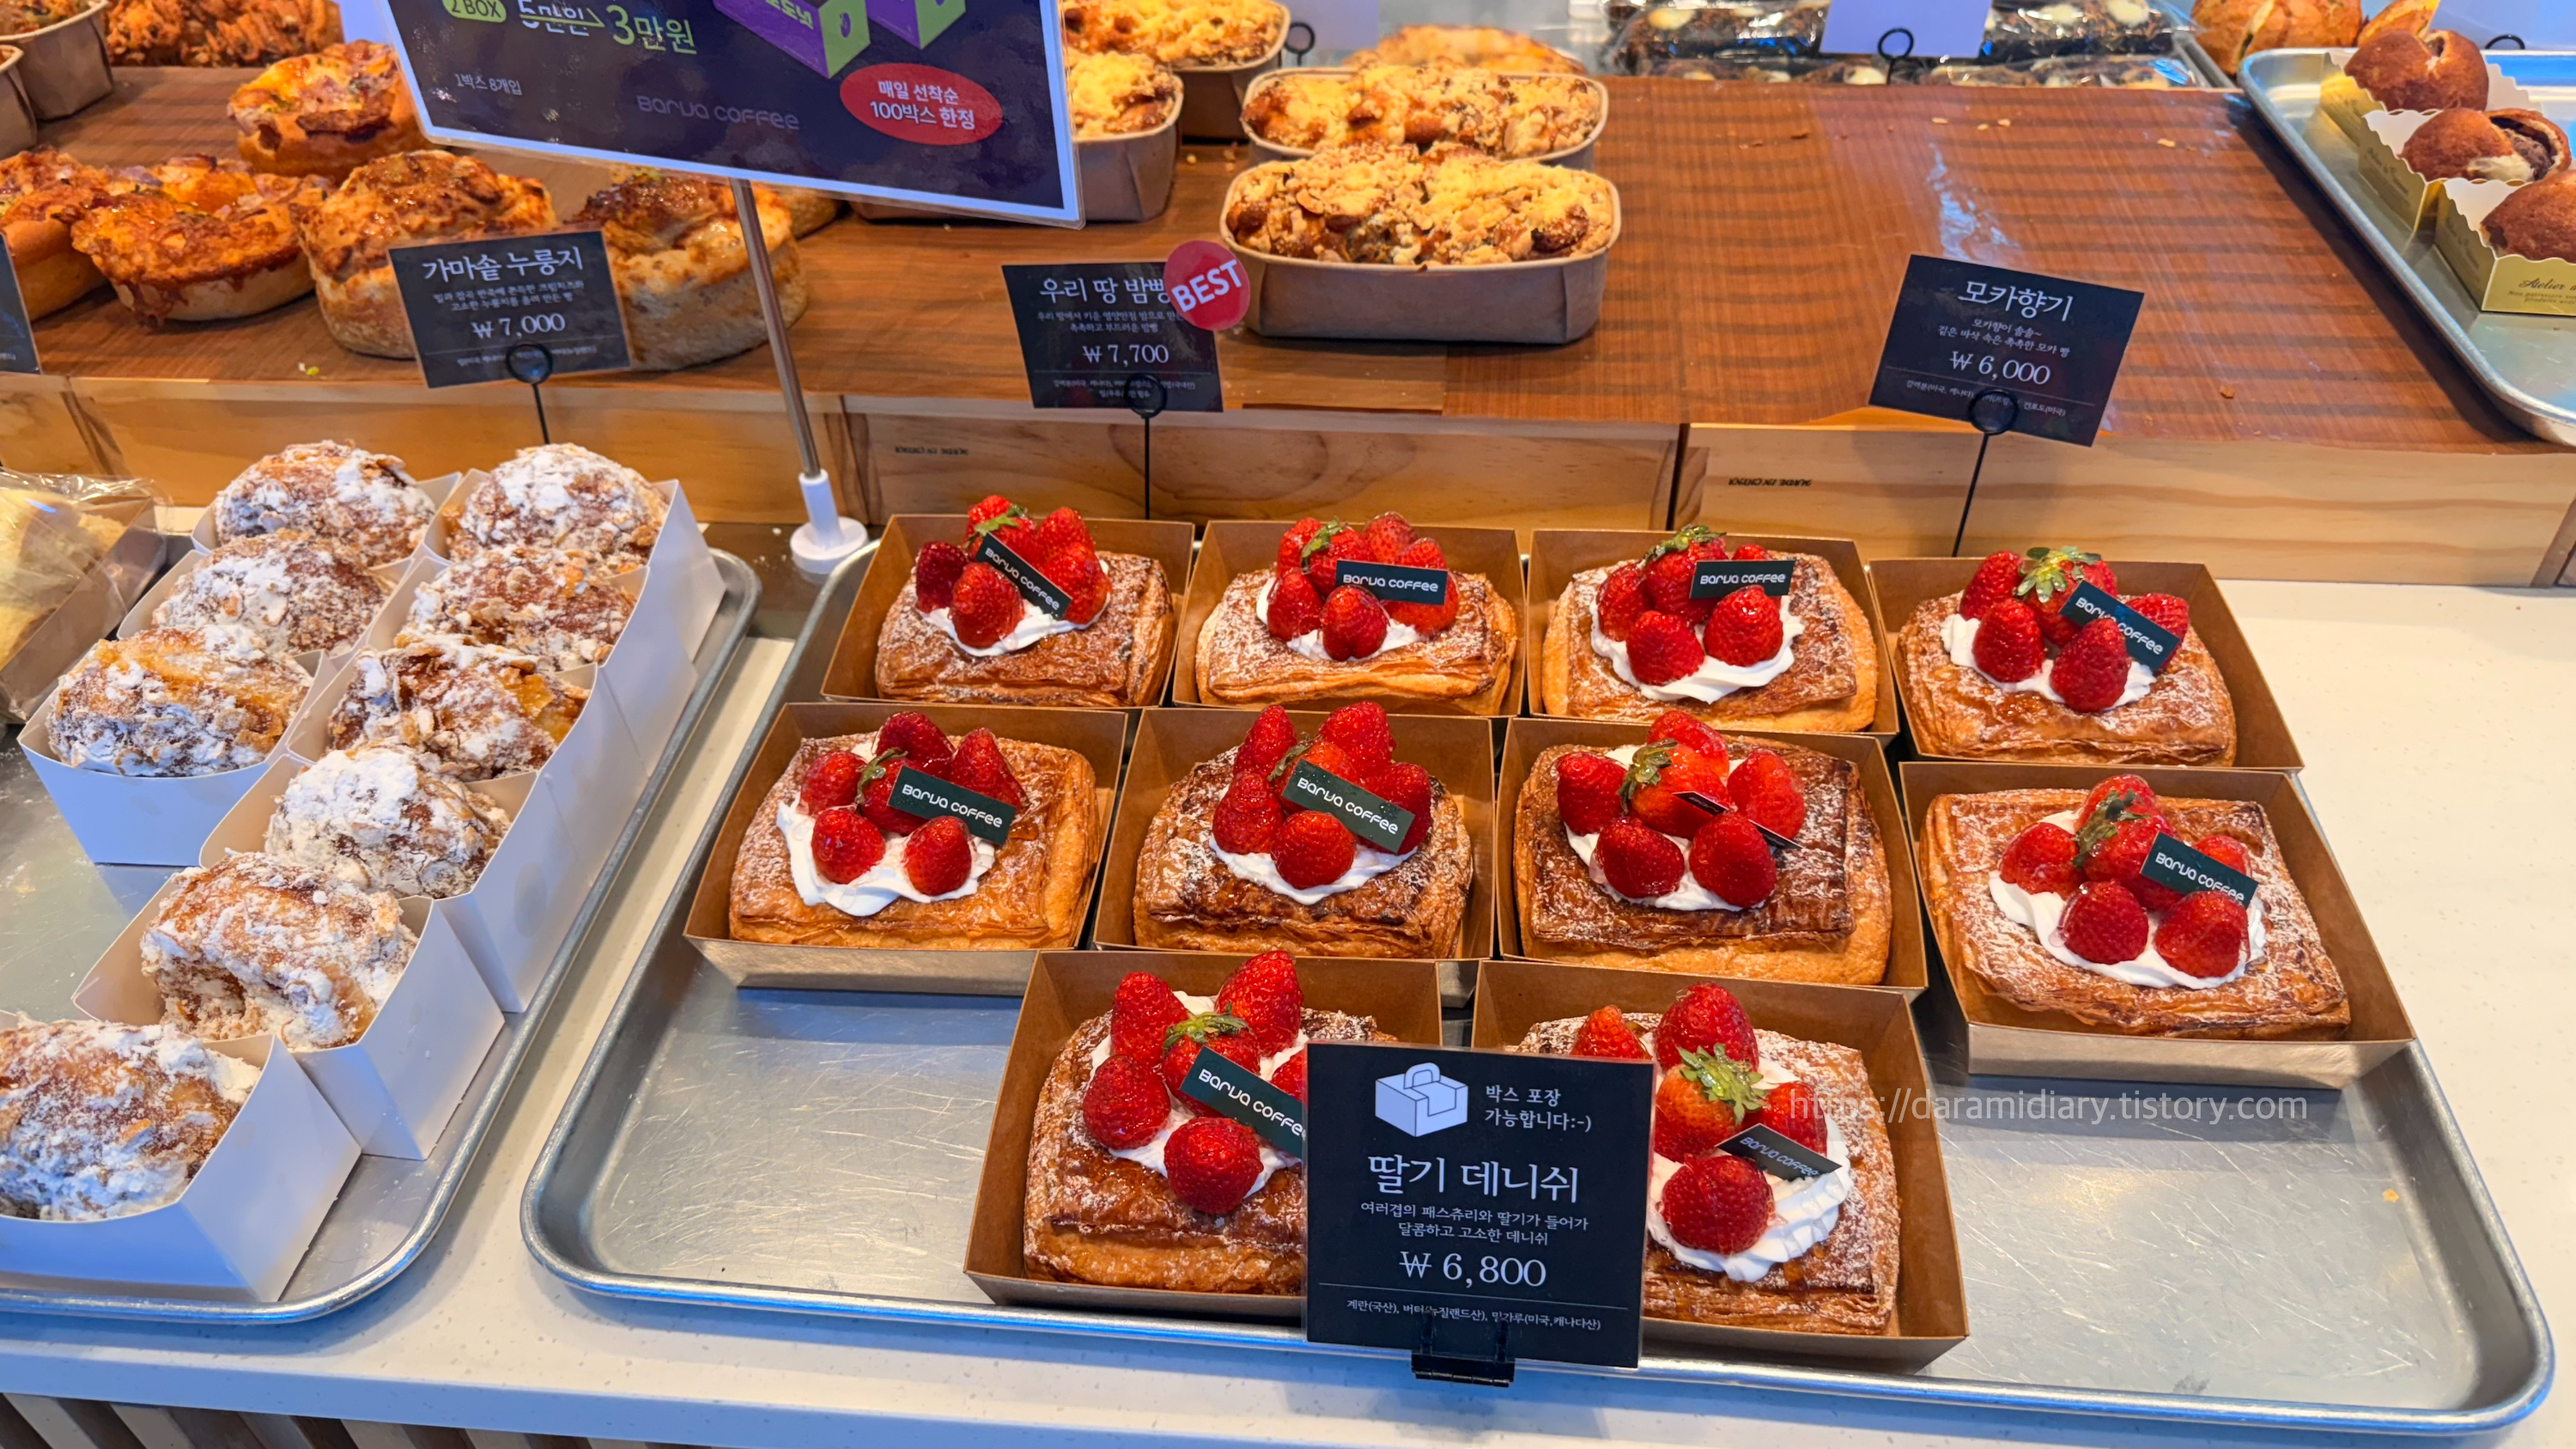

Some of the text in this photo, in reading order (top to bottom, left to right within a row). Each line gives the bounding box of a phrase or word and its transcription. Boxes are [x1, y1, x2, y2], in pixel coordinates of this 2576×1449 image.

[464, 0, 502, 19] BOX
[606, 5, 697, 55] 3만원
[454, 72, 523, 96] 1박스 8개입
[878, 80, 960, 106] 매일 선착순
[869, 100, 975, 131] 100박스 한정
[422, 246, 584, 283] 가마솥 누룽지
[1039, 277, 1088, 303] 우리
[1092, 277, 1119, 304] 땅
[1171, 259, 1242, 313] BEST
[2518, 277, 2567, 291] Atelier
[1957, 280, 2074, 322] 모카향기
[498, 312, 566, 340] 7,000
[1108, 344, 1170, 368] 7,700
[1978, 355, 2051, 386] 6,000
[1485, 1084, 1561, 1107] 박스 포장
[1484, 1107, 1592, 1133] 가능합니다:-)
[1368, 1154, 1579, 1203] 딸기 데니쉬
[1360, 1201, 1589, 1232] 여러겹의 패스츄리와 딸기가 들어가
[1398, 1221, 1548, 1246] 달콤하고 고소한 데니쉬
[1443, 1252, 1547, 1289] 6,800
